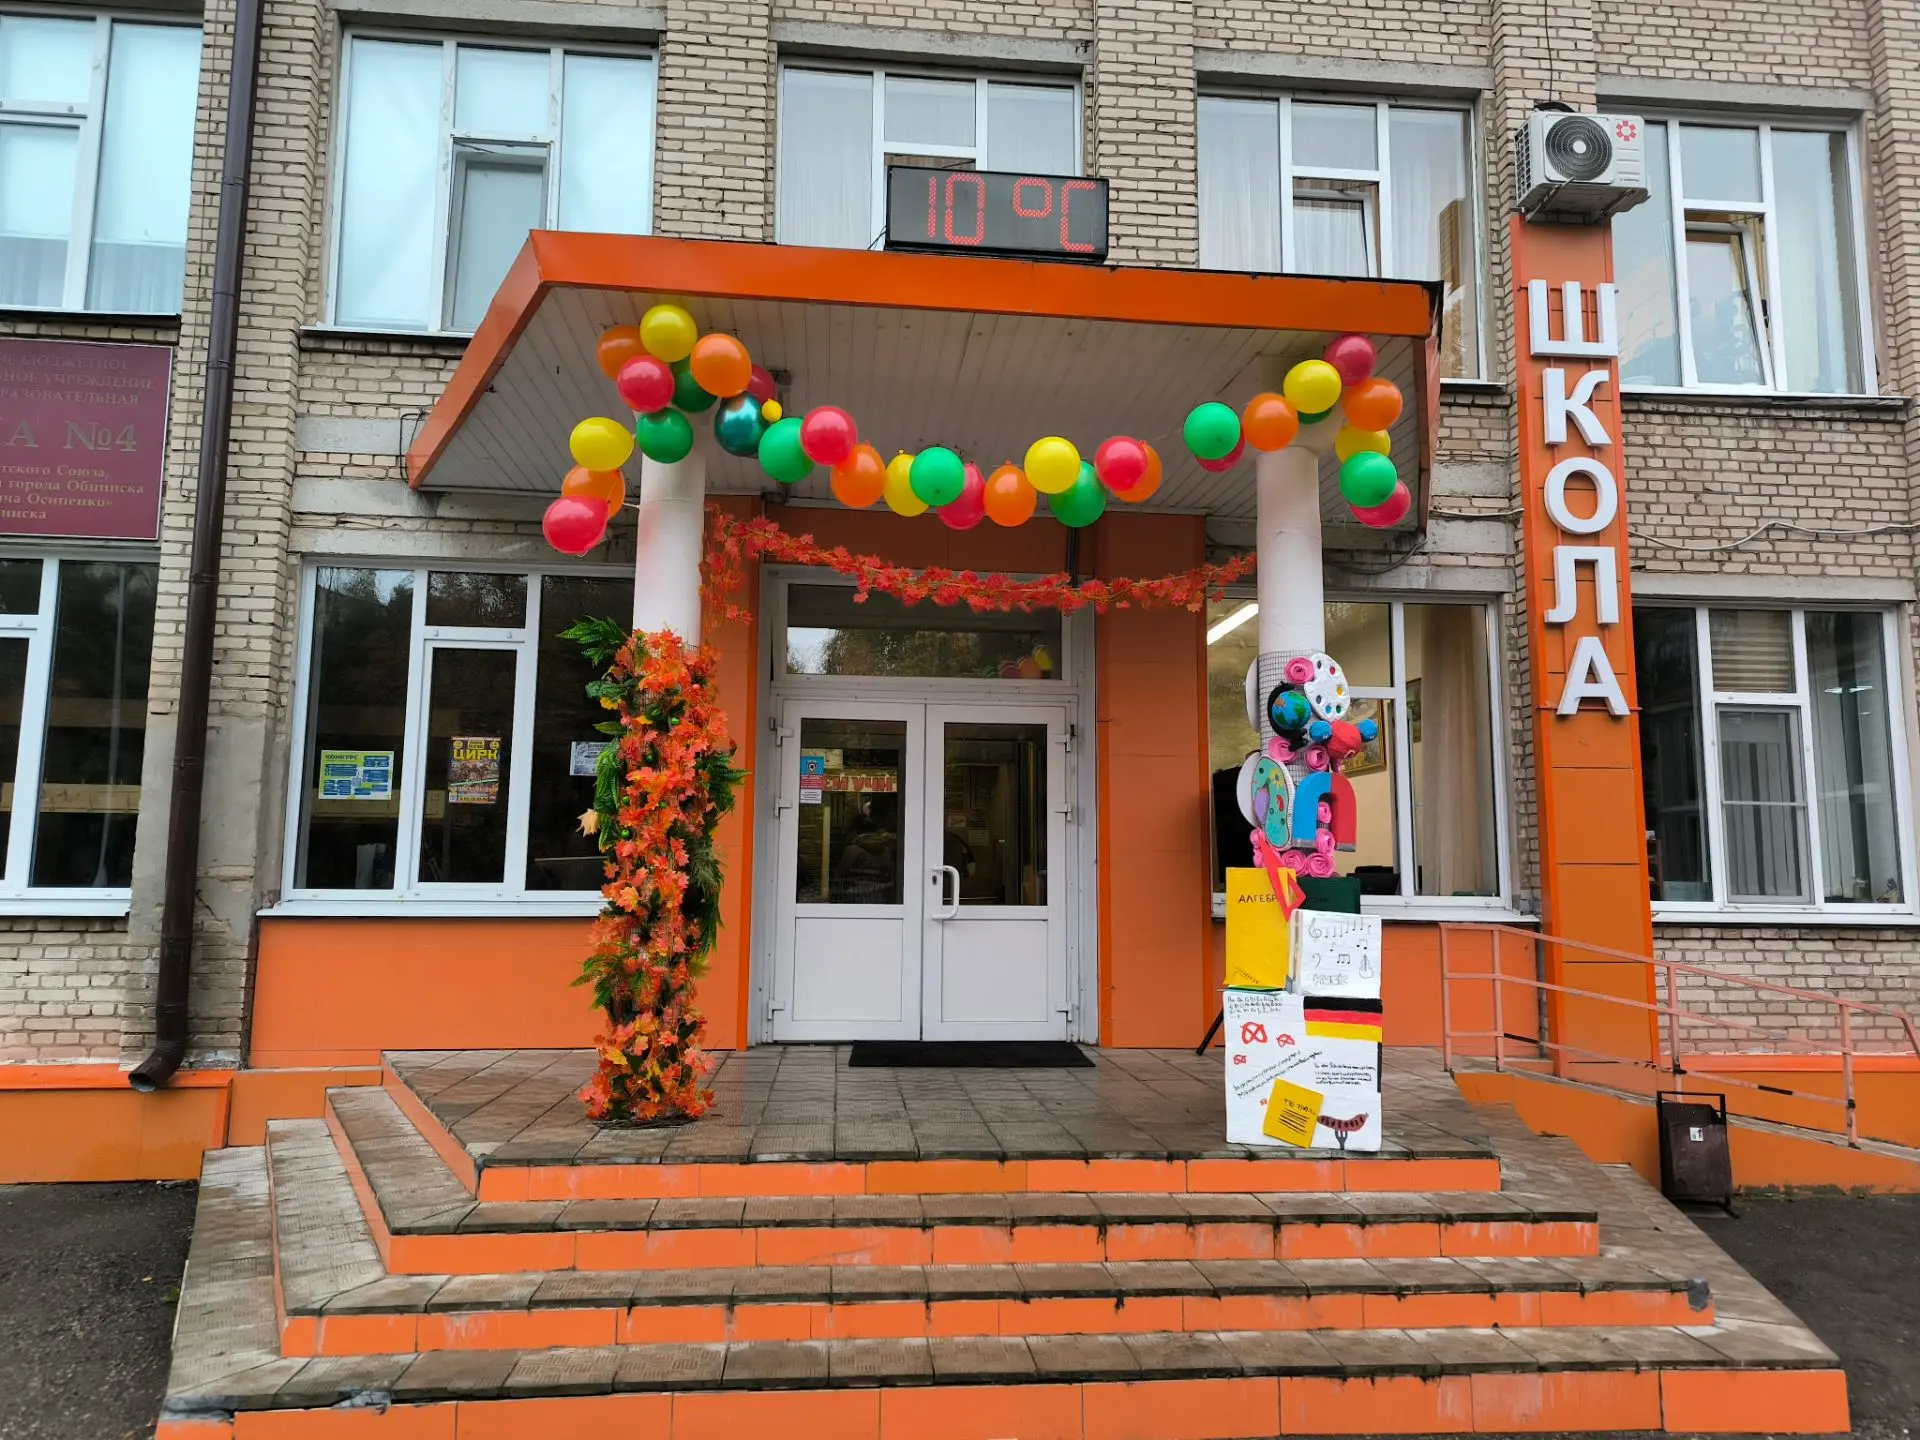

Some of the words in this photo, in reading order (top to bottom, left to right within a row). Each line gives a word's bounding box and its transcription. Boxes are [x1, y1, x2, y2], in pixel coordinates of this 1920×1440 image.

[927, 173, 985, 246] 10
[22, 354, 130, 370] БЮДЖЕТНОЕ
[44, 372, 155, 389] УЧРЕЖДЕНИЕ
[63, 420, 136, 452] №4
[9, 480, 60, 492] города
[67, 480, 144, 494] Обнинска
[1528, 279, 1630, 717] ШКОЛА
[453, 749, 498, 760] ЦИРК
[1238, 894, 1277, 904] АЛГЕБР
